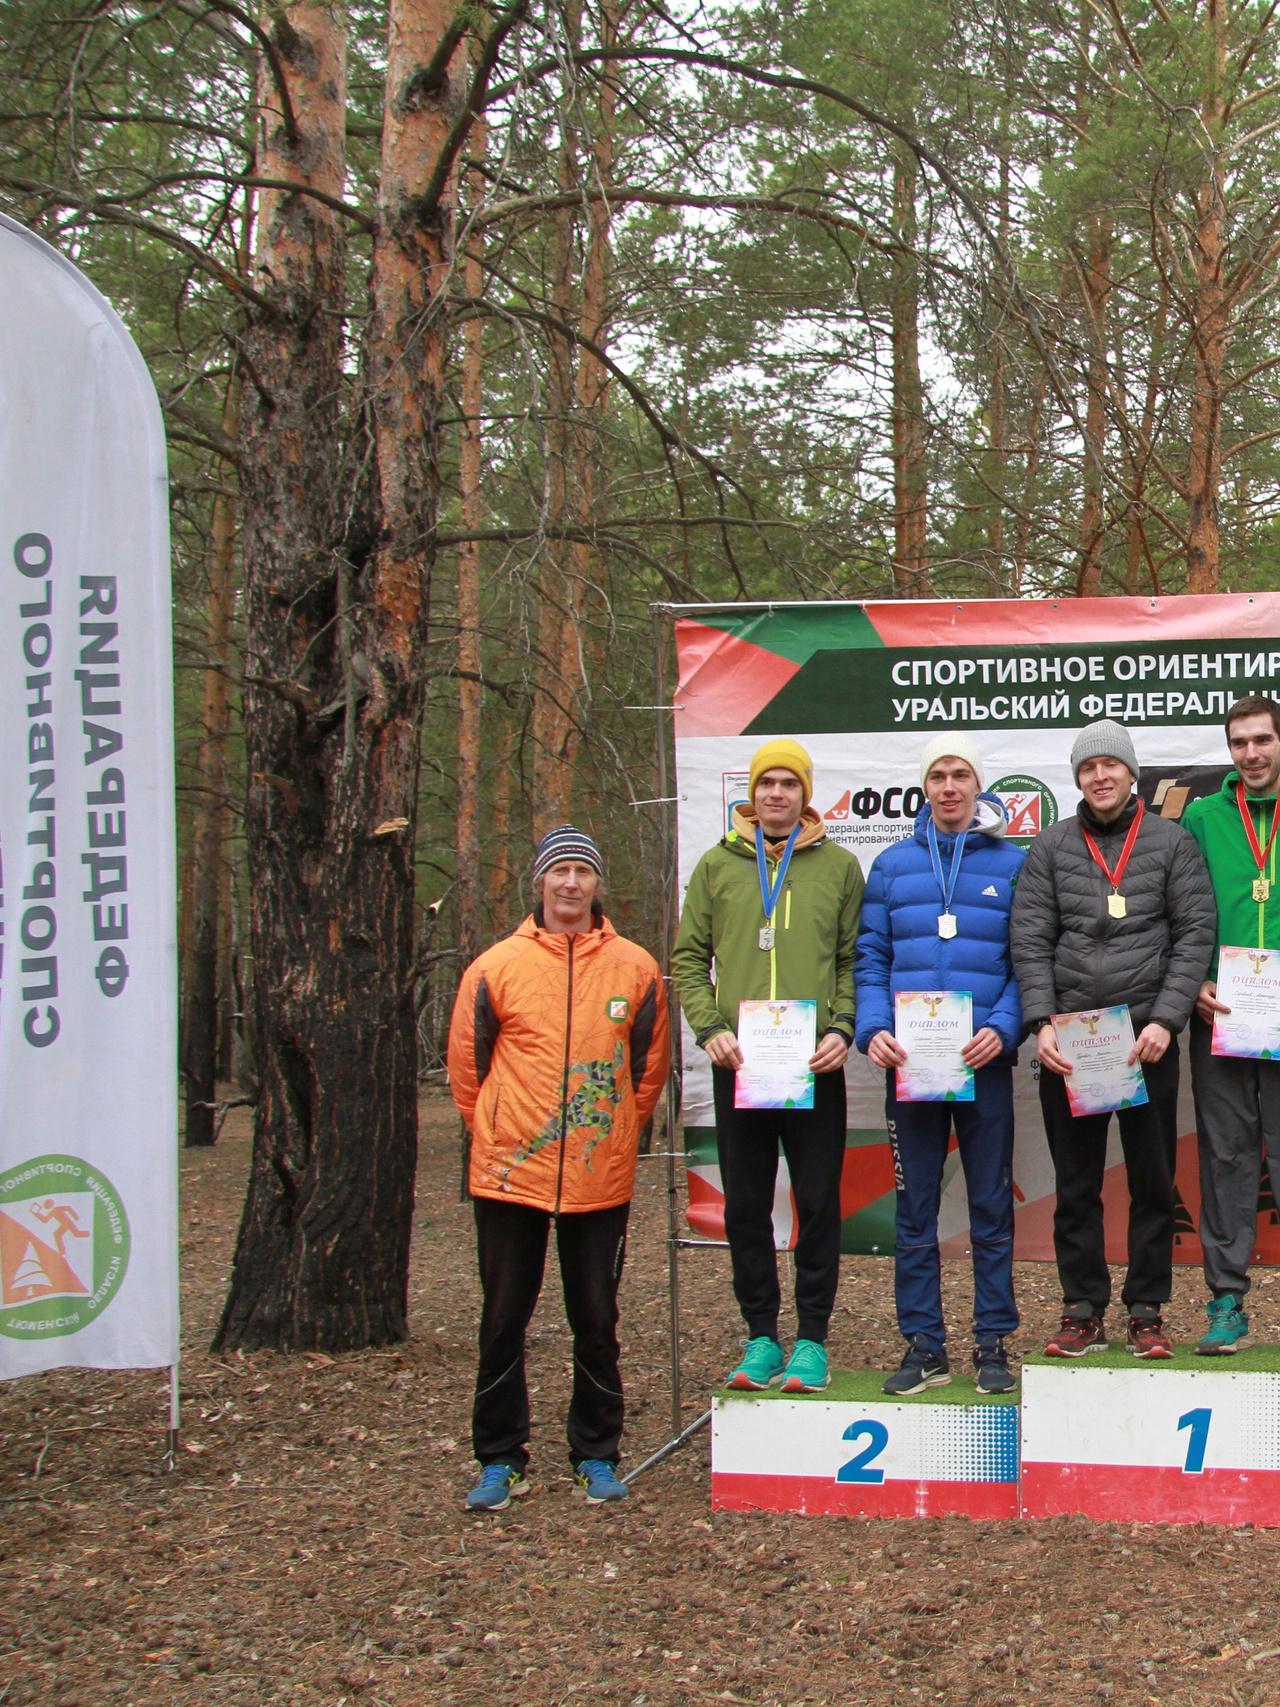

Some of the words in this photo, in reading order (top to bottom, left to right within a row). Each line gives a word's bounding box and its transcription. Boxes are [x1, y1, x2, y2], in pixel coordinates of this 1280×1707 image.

[891, 656, 1106, 686] СПОРТИВНОЕ
[892, 689, 1070, 722] УРАЛЬСКИЙ
[1002, 778, 1043, 791] СПОРТИВНОГО
[825, 824, 871, 834] едерация
[872, 824, 913, 835] спортив
[907, 1020, 959, 1029] ДИПЛОМ
[752, 1028, 802, 1036] ДИПЛОМ
[1070, 1034, 1121, 1048] ДИПЛОМ
[1176, 1407, 1213, 1474] 1
[836, 1419, 889, 1483] 2
